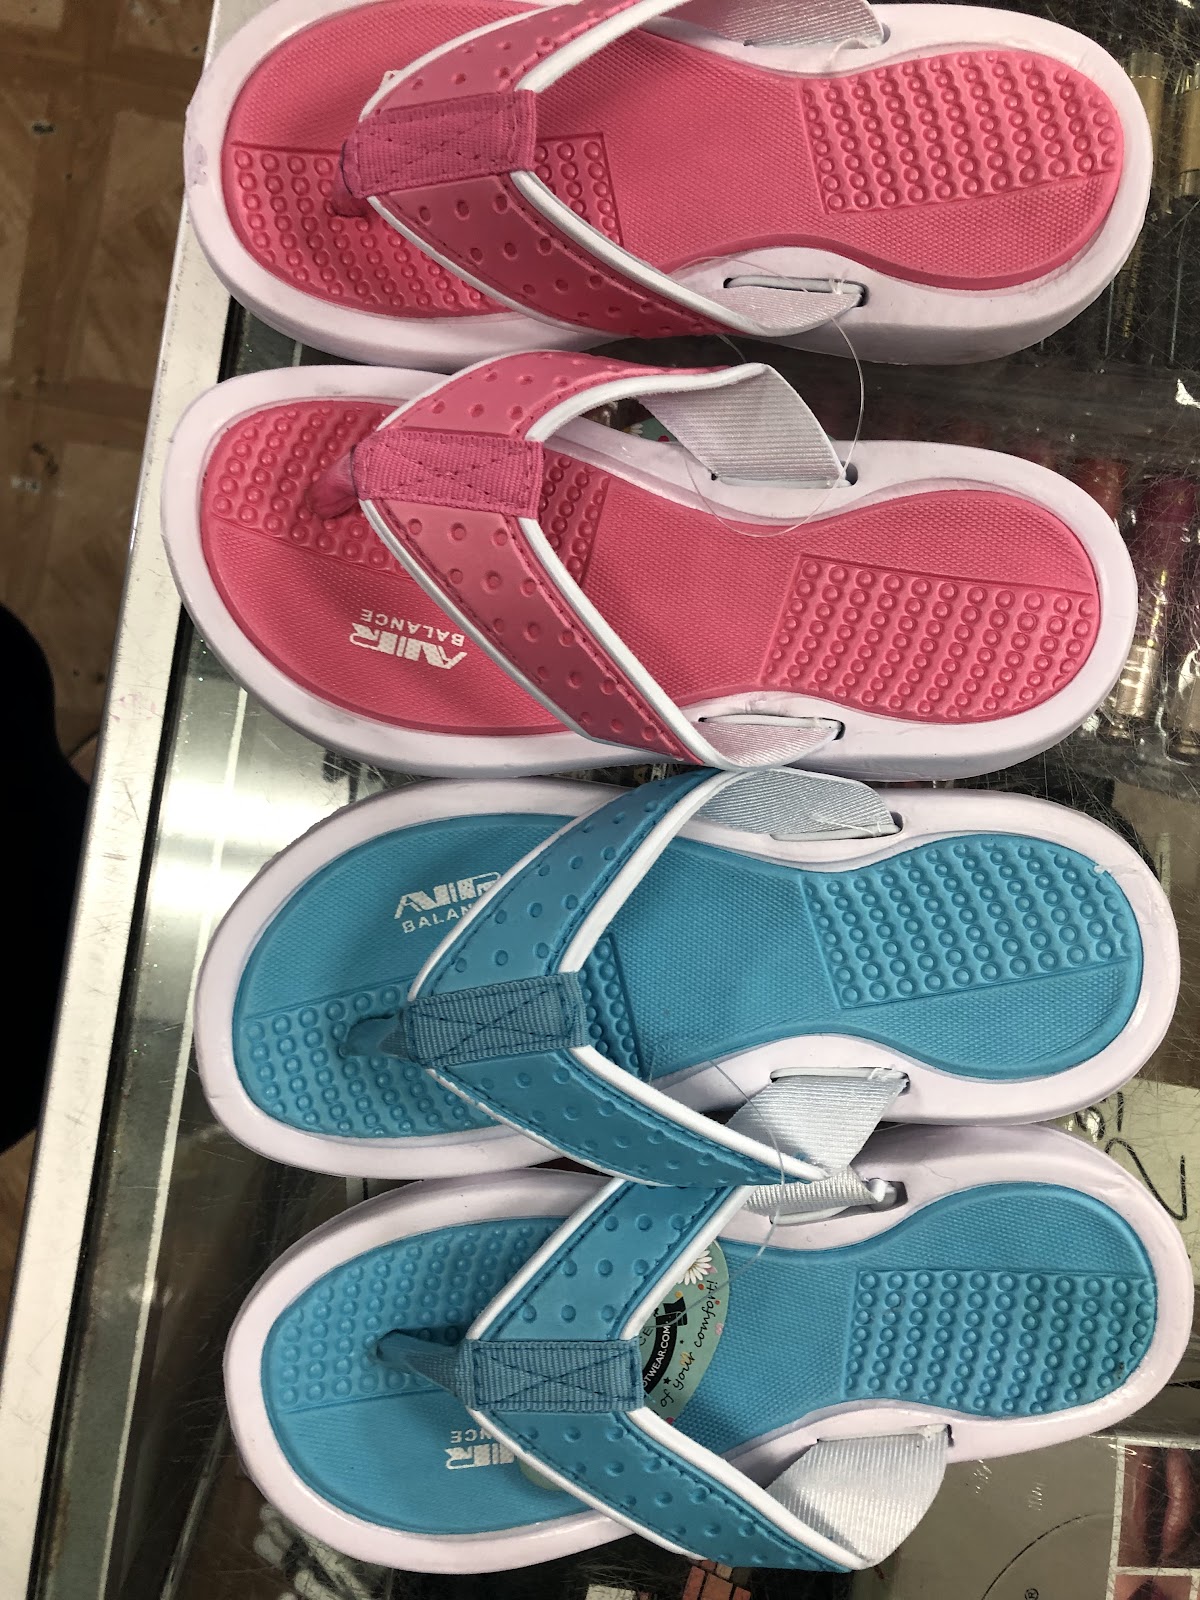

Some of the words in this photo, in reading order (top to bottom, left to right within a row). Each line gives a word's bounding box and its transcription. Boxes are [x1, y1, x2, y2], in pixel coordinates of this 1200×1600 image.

[360, 608, 465, 647] BALANCE
[402, 903, 474, 933] BALAN
[642, 1324, 671, 1387] OTWEAR.COM
[660, 1388, 674, 1407] of
[673, 1352, 696, 1391] your
